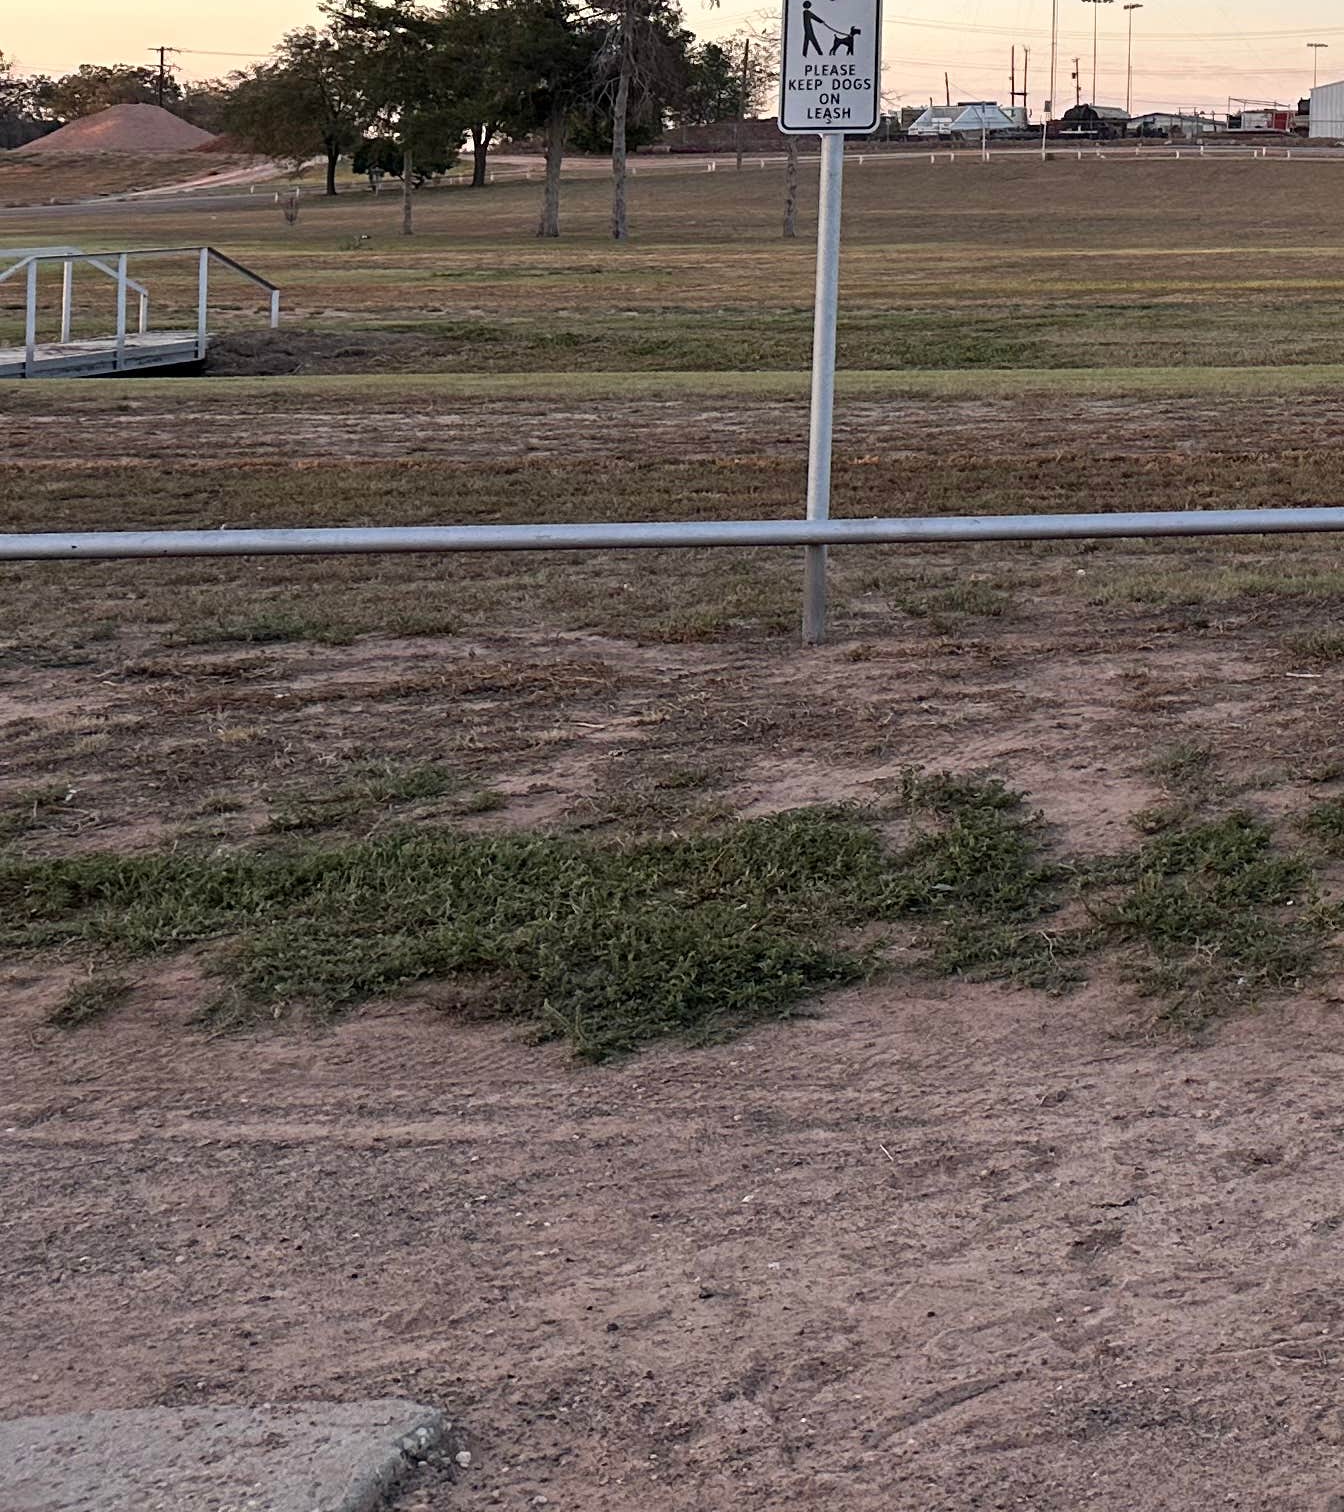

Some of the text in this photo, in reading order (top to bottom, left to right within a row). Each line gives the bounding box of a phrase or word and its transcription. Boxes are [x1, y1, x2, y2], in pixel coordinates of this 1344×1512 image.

[804, 64, 856, 77] PLEASE
[788, 78, 872, 91] KEEP DOGS
[819, 93, 841, 105] ON
[807, 107, 852, 120] LEASH
